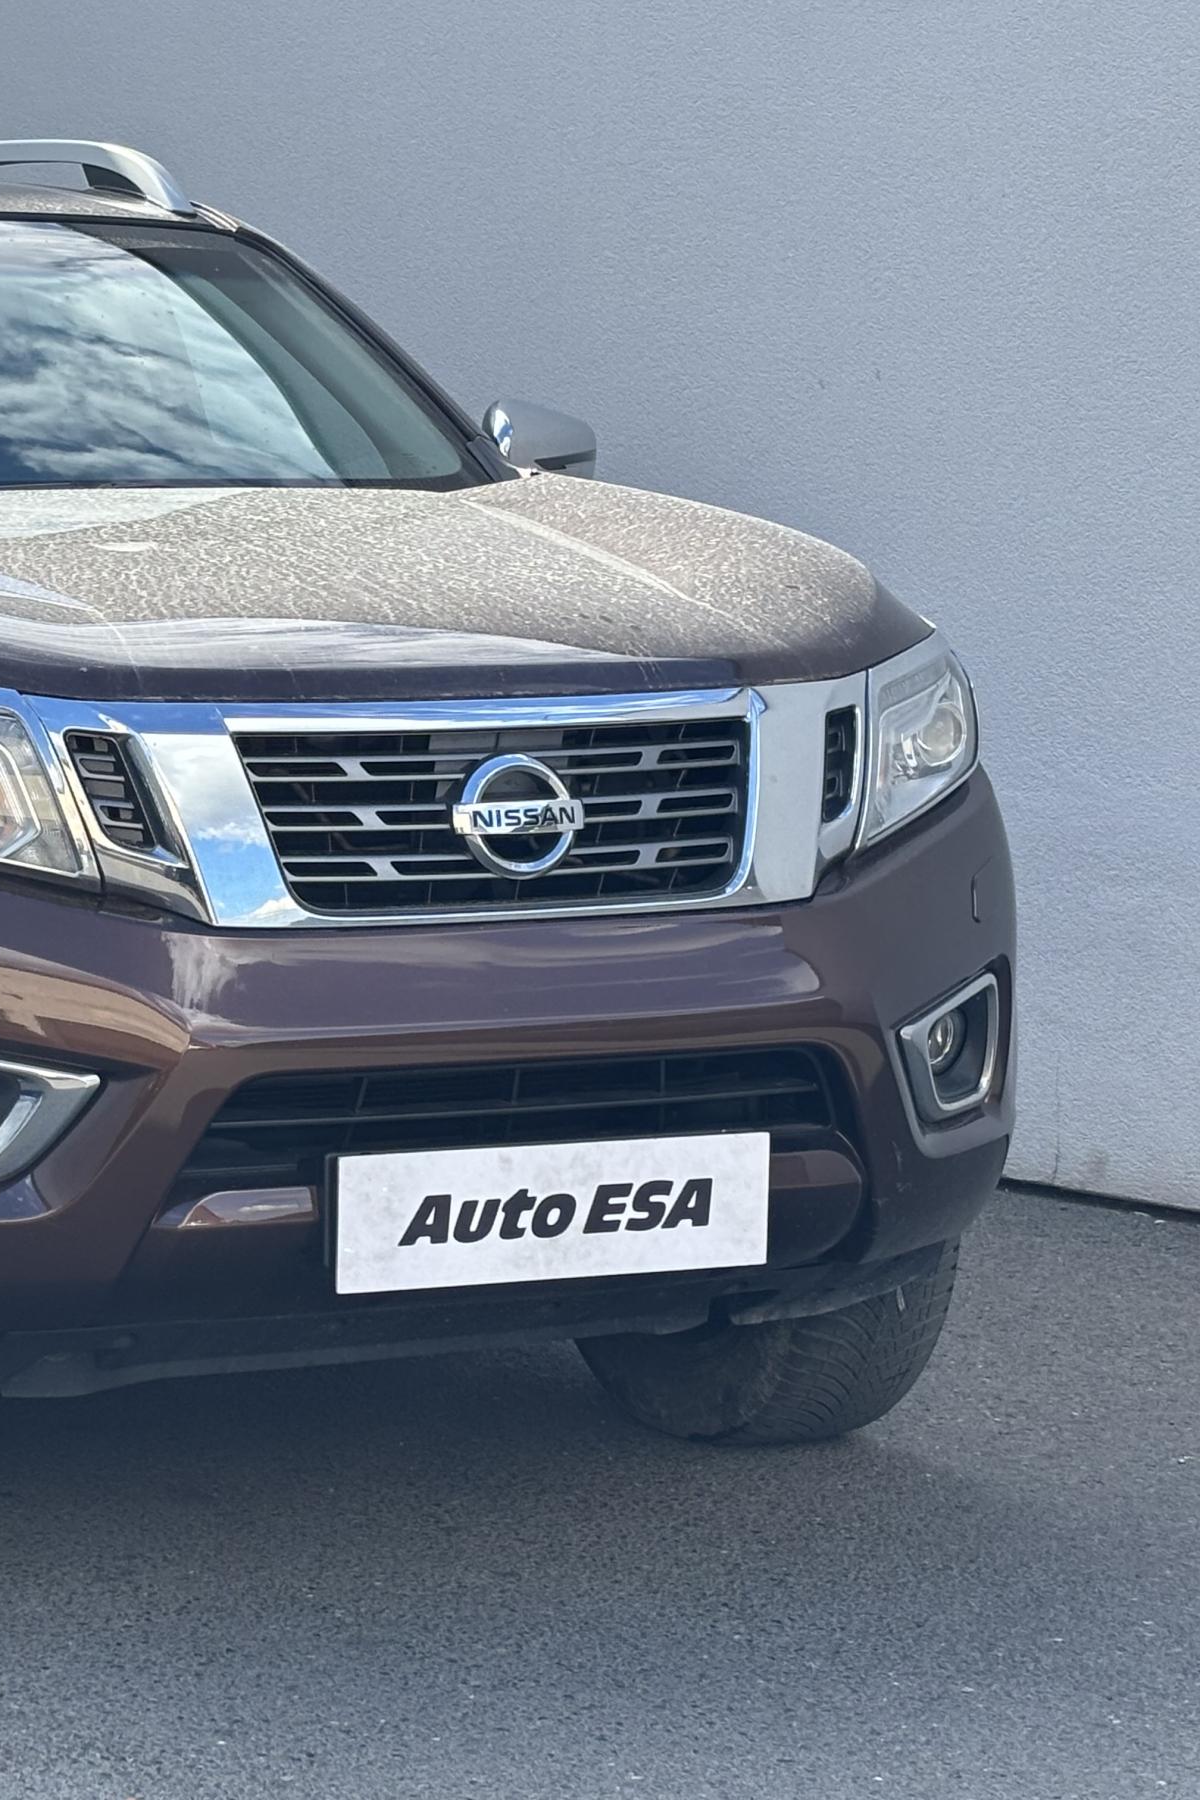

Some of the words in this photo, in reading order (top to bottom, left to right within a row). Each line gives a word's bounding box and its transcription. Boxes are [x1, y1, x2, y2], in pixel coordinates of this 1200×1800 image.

[472, 806, 575, 828] NISSAN
[398, 1188, 577, 1247] Auto
[582, 1178, 713, 1234] ESA
